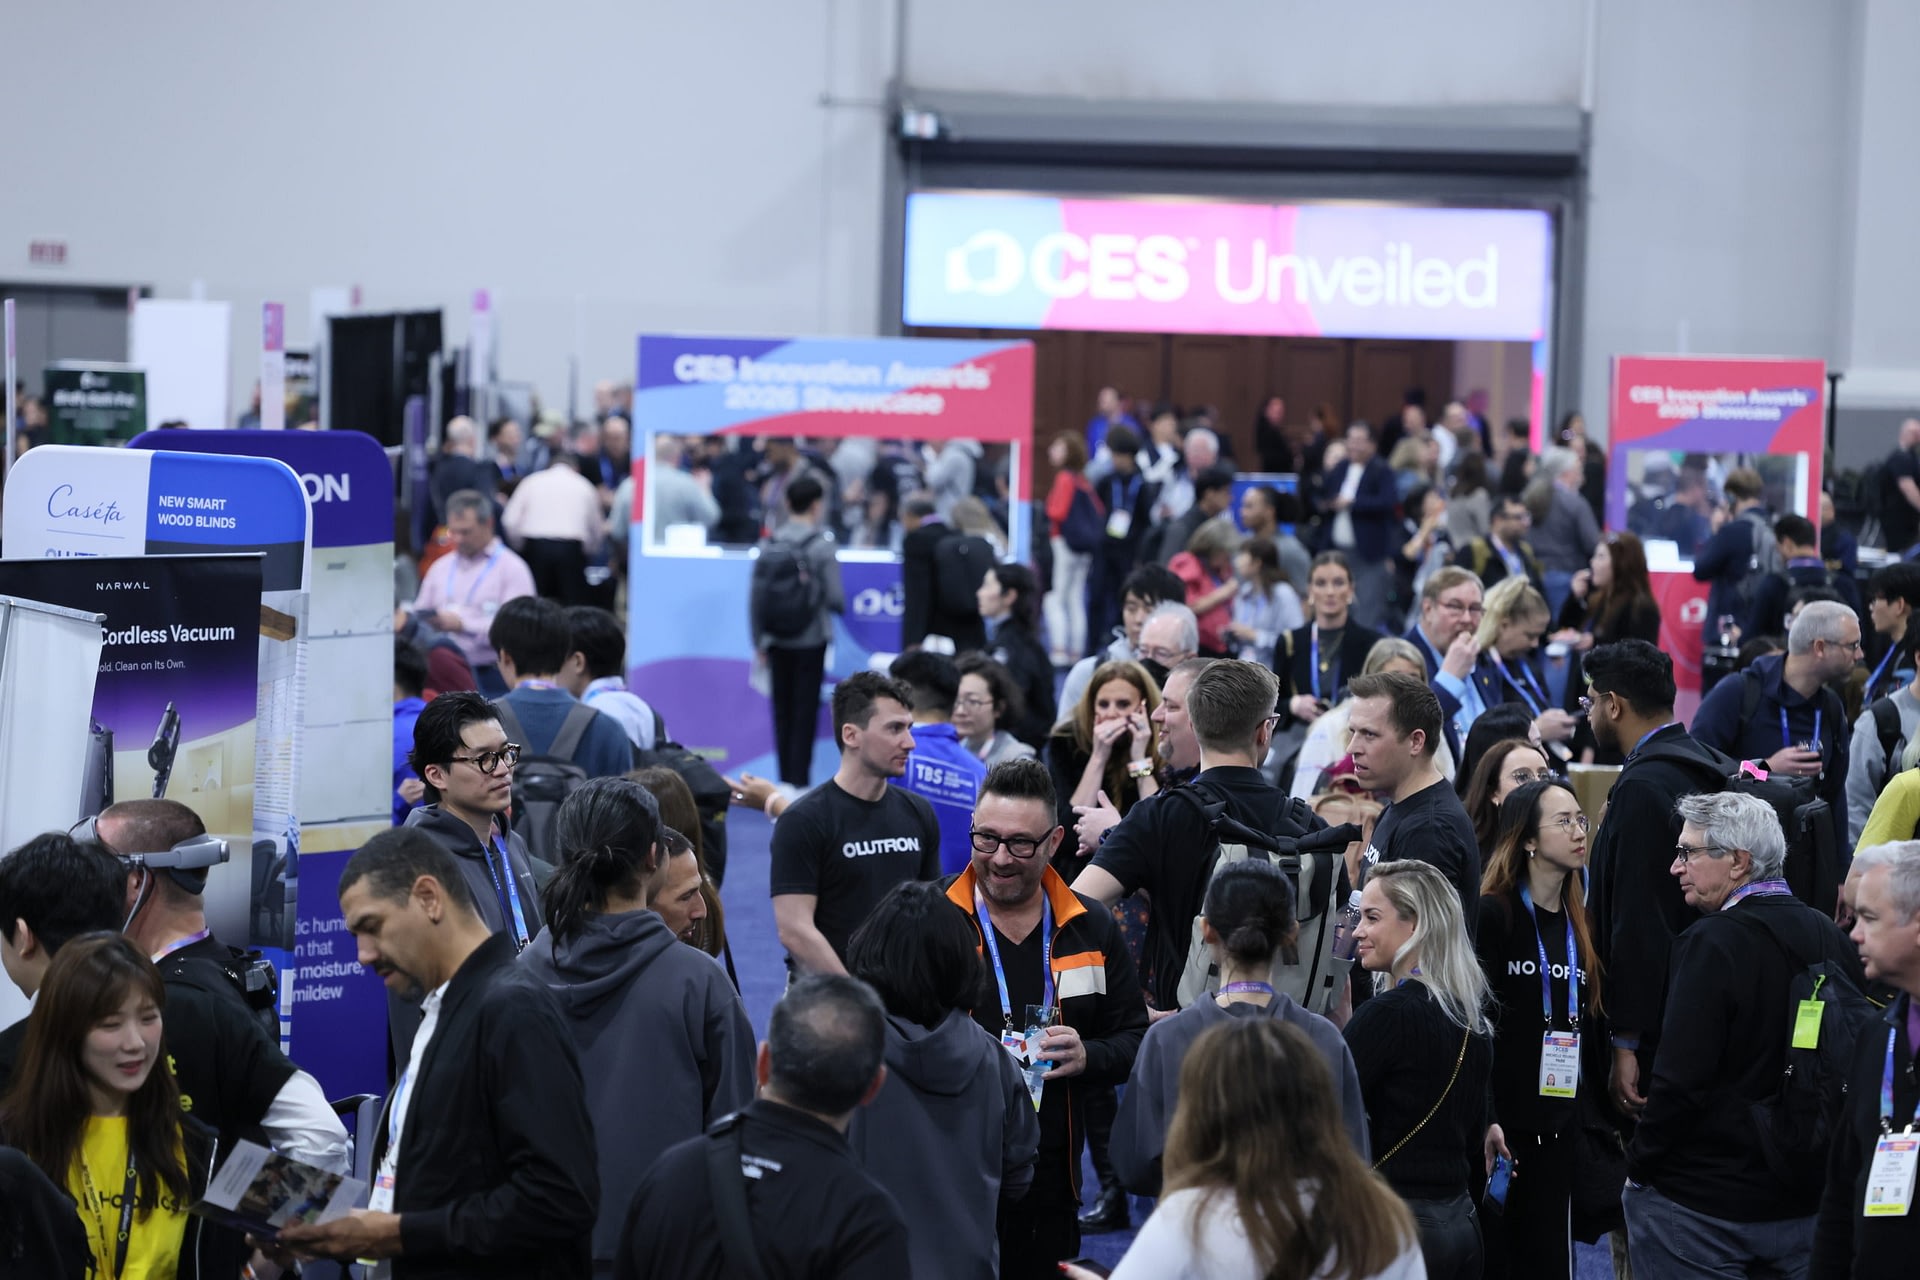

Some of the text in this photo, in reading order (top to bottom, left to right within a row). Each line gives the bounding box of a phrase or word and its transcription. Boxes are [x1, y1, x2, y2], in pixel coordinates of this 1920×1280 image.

[1030, 232, 1498, 308] CES Unveiled
[738, 356, 882, 387] Innovation
[47, 484, 126, 525] Caséta
[158, 495, 227, 510] NEW SMART
[157, 513, 237, 529] WOOD BLINDS
[96, 582, 150, 591] NARWAL
[101, 624, 235, 646] Cordless Vacuum
[115, 661, 138, 672] Clean
[140, 662, 153, 671] on
[154, 660, 165, 670] Its
[166, 659, 186, 670] Own.
[915, 763, 943, 785] TBS
[307, 940, 334, 958] that
[1507, 960, 1536, 976] NO
[292, 983, 344, 1003] mildew
